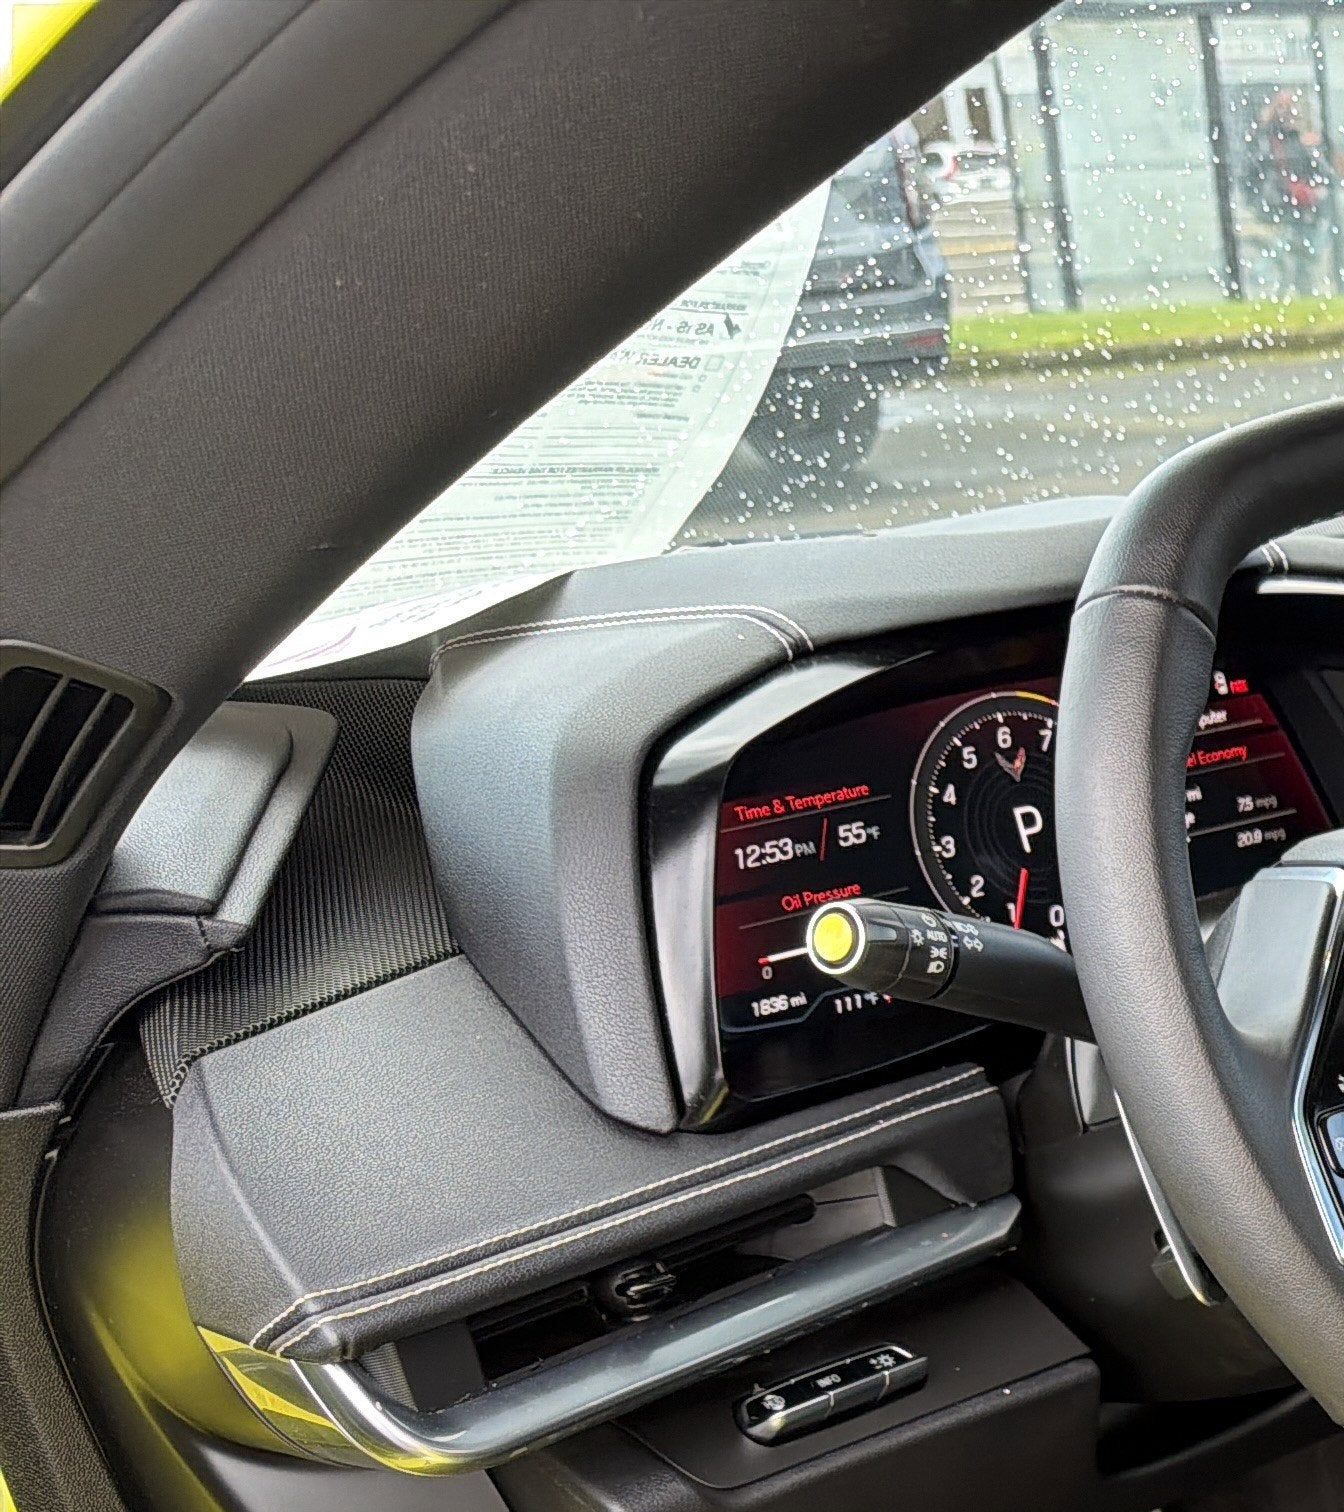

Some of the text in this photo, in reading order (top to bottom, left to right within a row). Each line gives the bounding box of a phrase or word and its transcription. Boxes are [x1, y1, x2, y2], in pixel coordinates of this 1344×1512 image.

[997, 726, 1012, 749] 6
[1039, 729, 1053, 752] 7
[962, 746, 978, 769] 5
[1197, 745, 1248, 766] Economy
[734, 785, 870, 821] Time & Temperature
[942, 783, 957, 805] 4
[1013, 805, 1043, 853] P
[734, 837, 794, 870] 12:53
[940, 836, 956, 859] 3
[781, 884, 862, 912] Oil Pressure
[970, 875, 985, 898] 2
[1049, 905, 1064, 927] 0
[762, 966, 773, 980] 0
